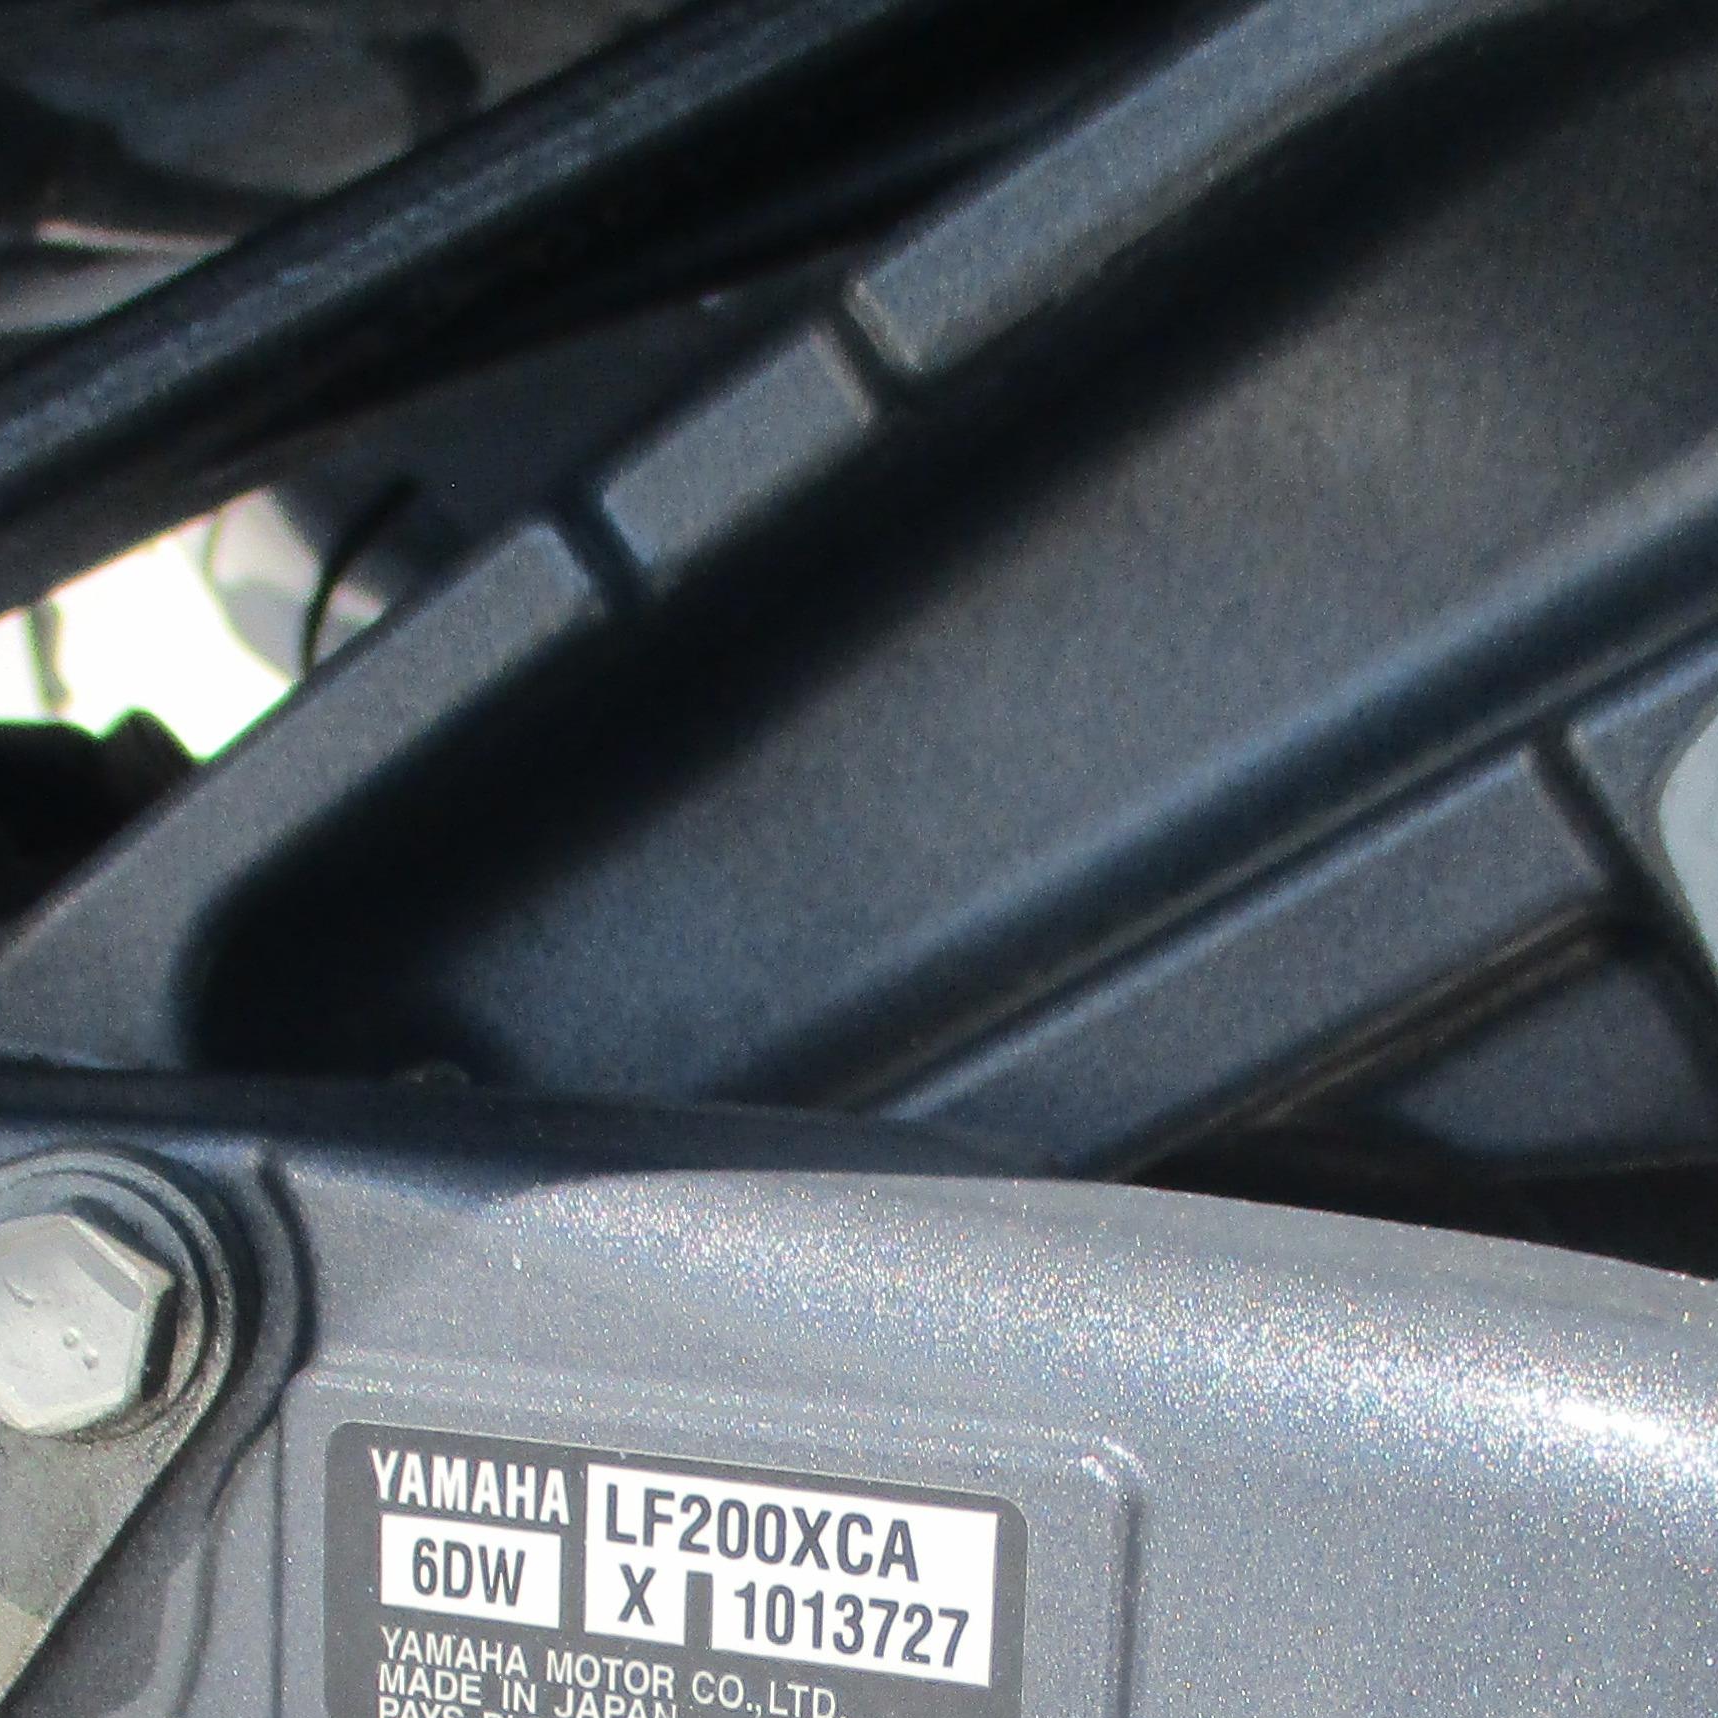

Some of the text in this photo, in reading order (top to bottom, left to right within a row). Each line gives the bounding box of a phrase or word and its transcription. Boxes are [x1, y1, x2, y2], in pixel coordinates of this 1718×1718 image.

[371, 1448, 570, 1525] YAMAHA
[605, 1483, 919, 1582] LF200XCA
[412, 1537, 525, 1607] 6DW
[619, 1564, 969, 1668] X 1013727
[378, 1662, 481, 1706] MADE
[502, 1677, 538, 1714] IN
[381, 1626, 528, 1679] YAMAHA
[546, 1650, 675, 1699] MOTOR
